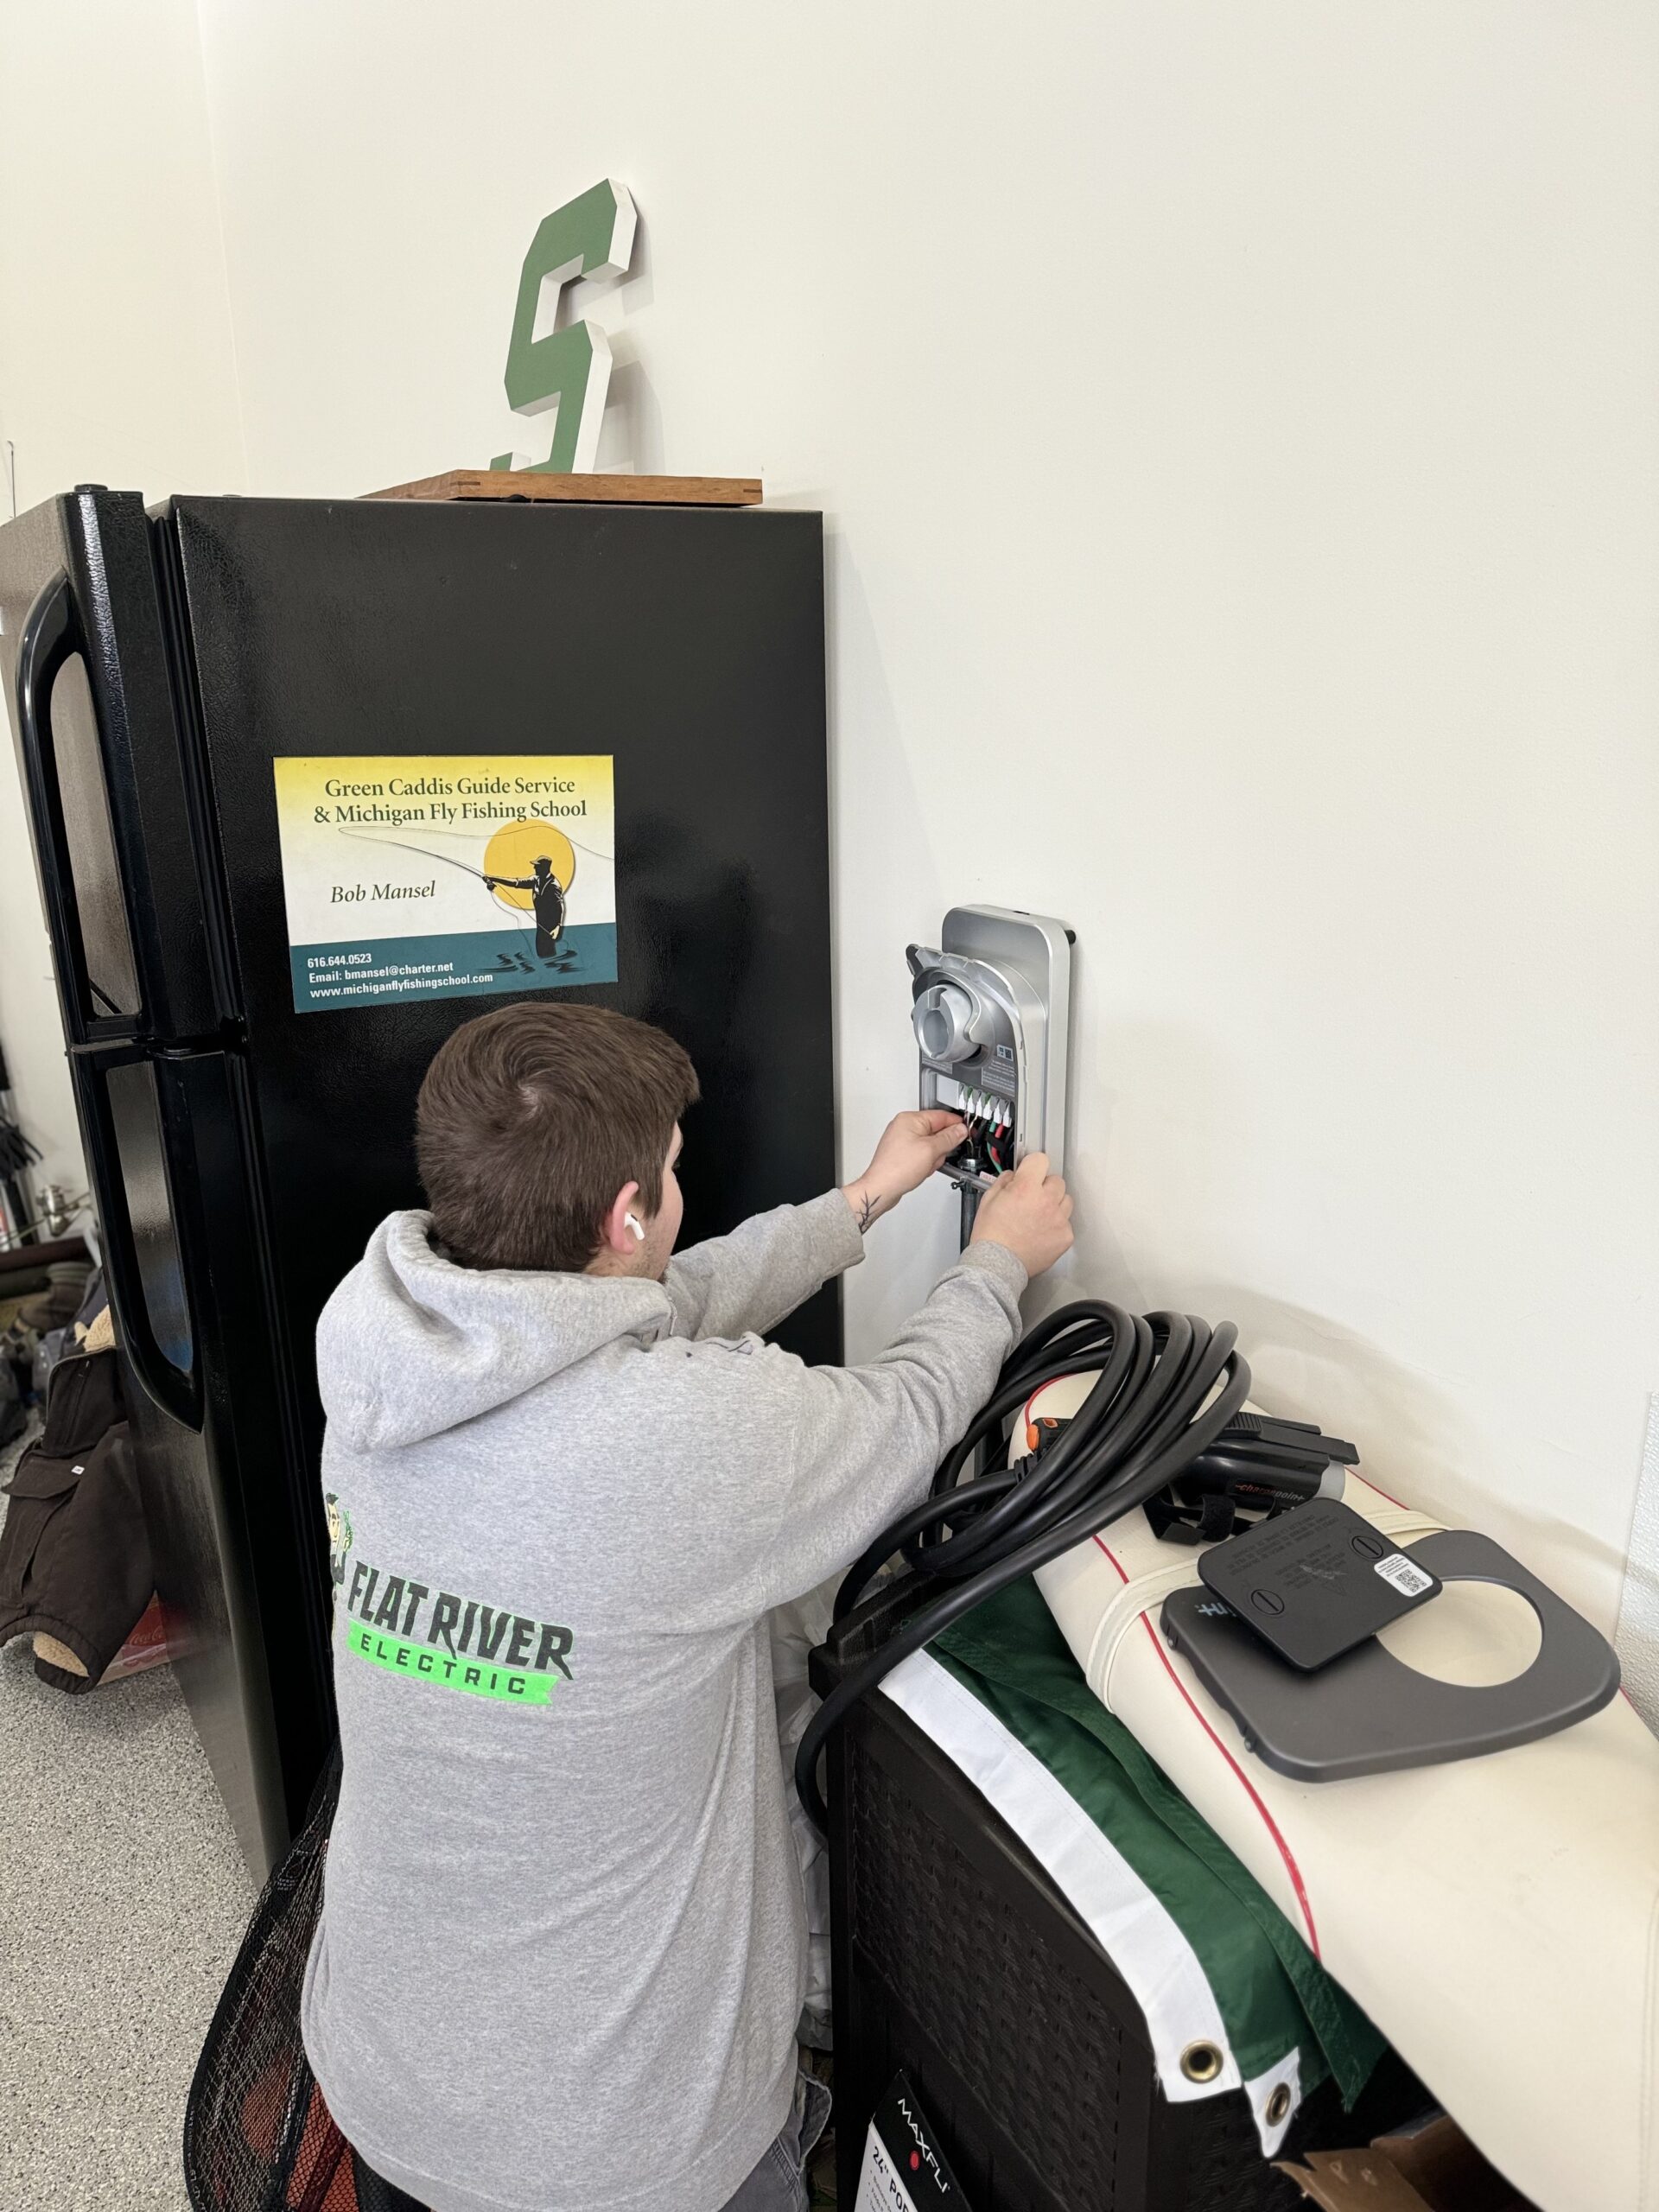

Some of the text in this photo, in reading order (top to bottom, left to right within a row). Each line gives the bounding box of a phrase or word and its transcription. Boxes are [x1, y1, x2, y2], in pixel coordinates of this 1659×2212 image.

[325, 776, 575, 798] Green Caddis Guide Service
[314, 799, 588, 826] & Michigan Fly Fishing School
[330, 880, 435, 904] Bob Mansel
[307, 953, 372, 969] 616.644.0523
[308, 962, 454, 984] Email: bmansel@charter.net
[309, 973, 493, 999] www.michiganflyfishingschool.com
[347, 1560, 575, 1681] FLAT RIVER
[359, 1632, 526, 1695] ELECTRIC
[897, 2097, 949, 2194] MAXFLI
